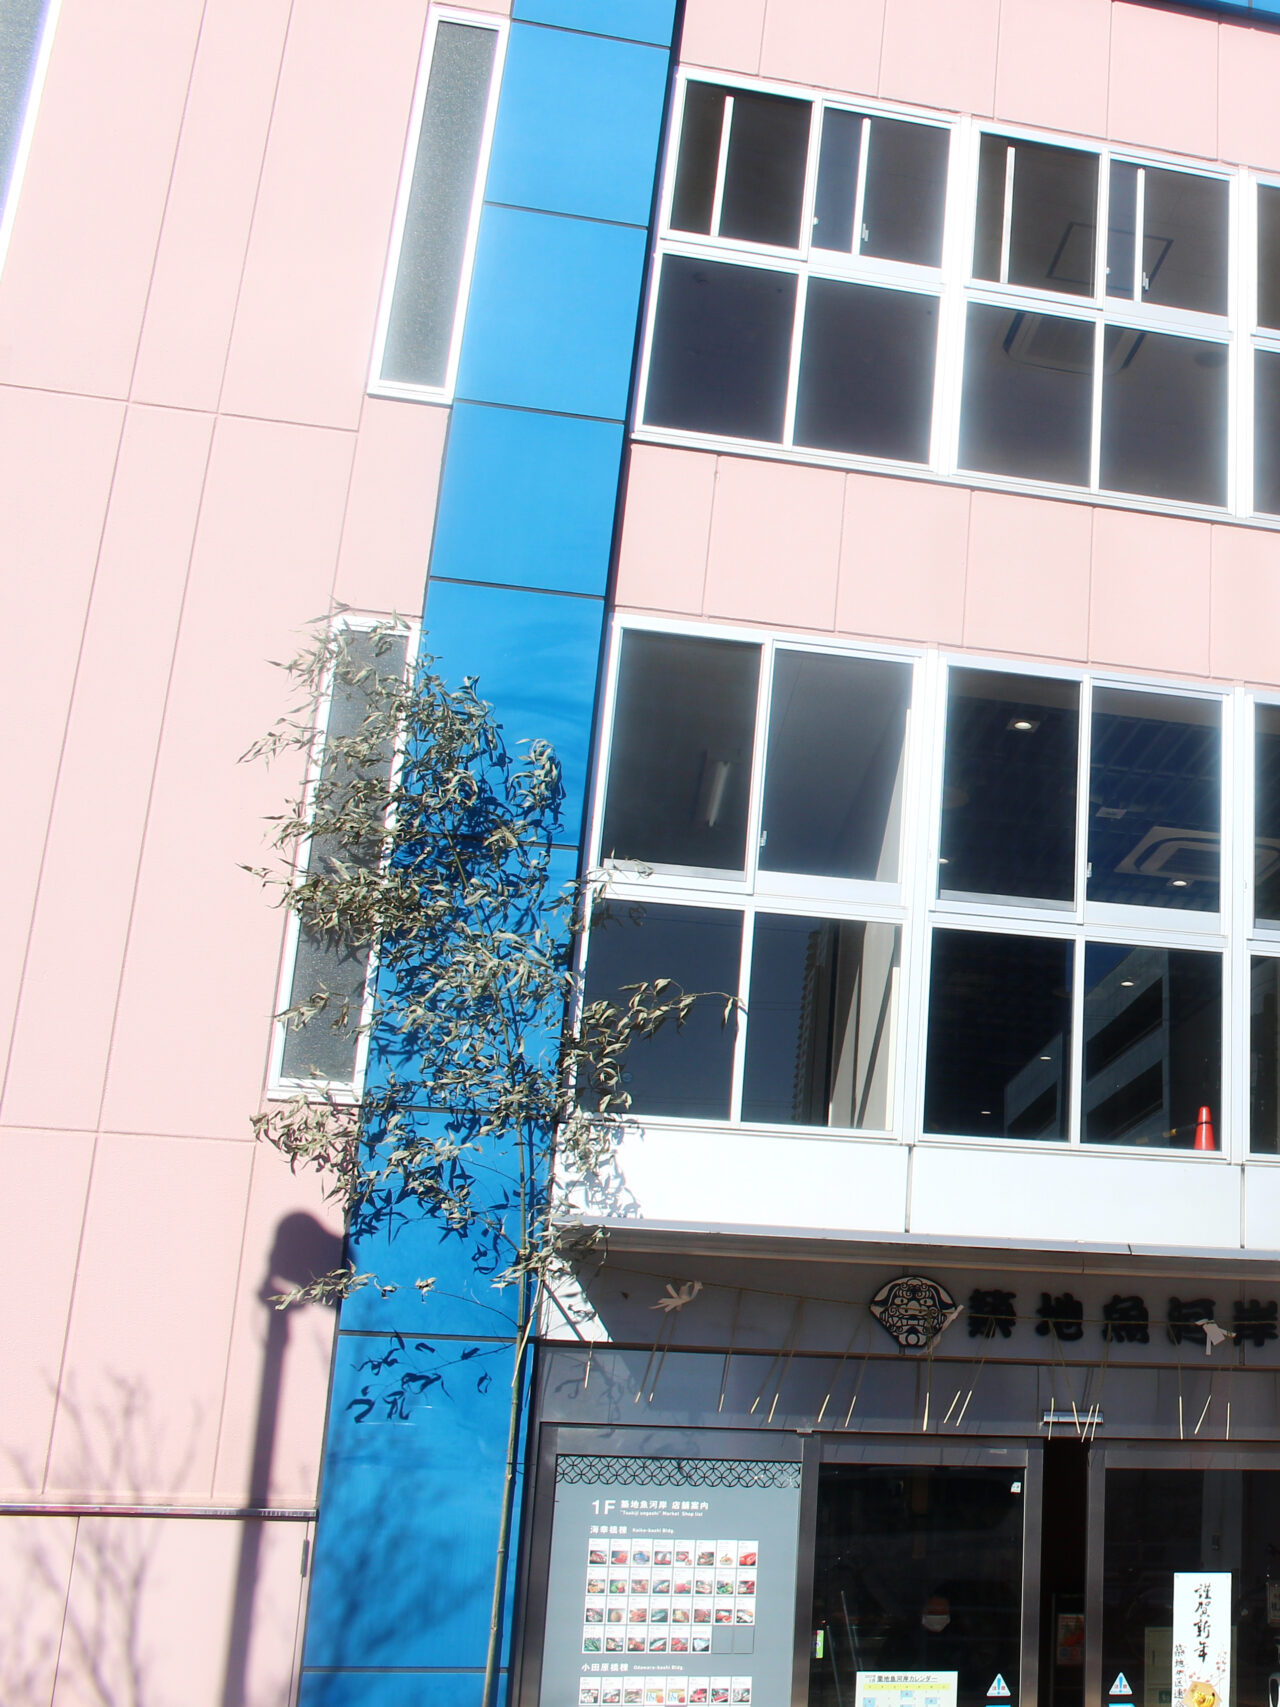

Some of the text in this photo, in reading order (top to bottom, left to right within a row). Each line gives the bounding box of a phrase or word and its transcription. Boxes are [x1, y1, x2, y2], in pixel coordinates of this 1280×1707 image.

[592, 1499, 616, 1515] 1F
[1193, 1583, 1212, 1664] 謹賀新年
[581, 1663, 629, 1672] 小田原橋棟
